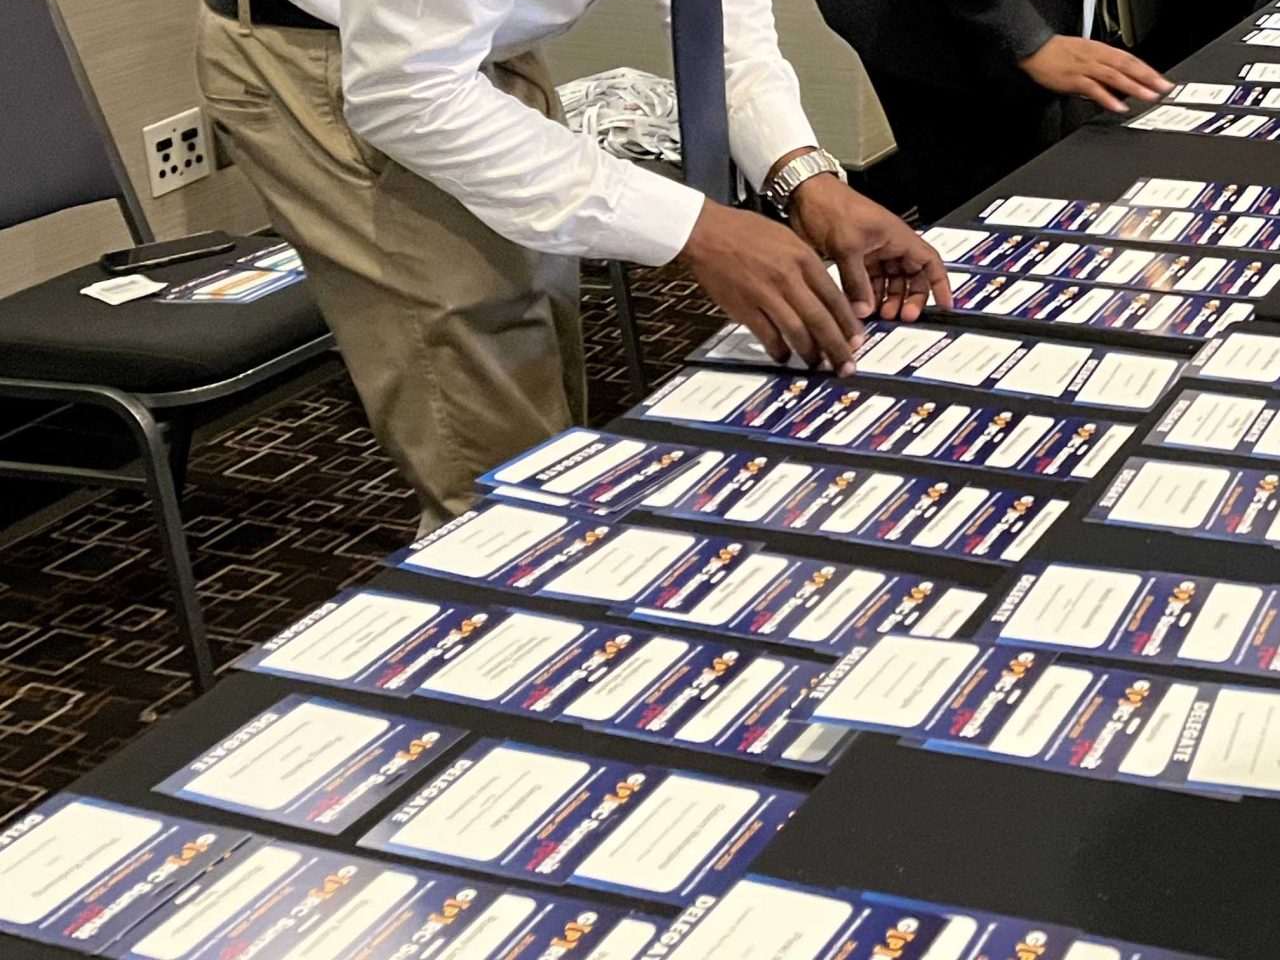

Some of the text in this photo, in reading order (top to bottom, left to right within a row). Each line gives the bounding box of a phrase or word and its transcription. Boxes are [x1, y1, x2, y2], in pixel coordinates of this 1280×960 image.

[262, 602, 339, 652] DELEGATE
[809, 645, 868, 700] DELEGATE
[190, 712, 280, 773] DELEGATE
[1172, 700, 1211, 763] DELEGATE
[391, 758, 475, 824] DELEGATE
[640, 895, 717, 960] DELEGA
